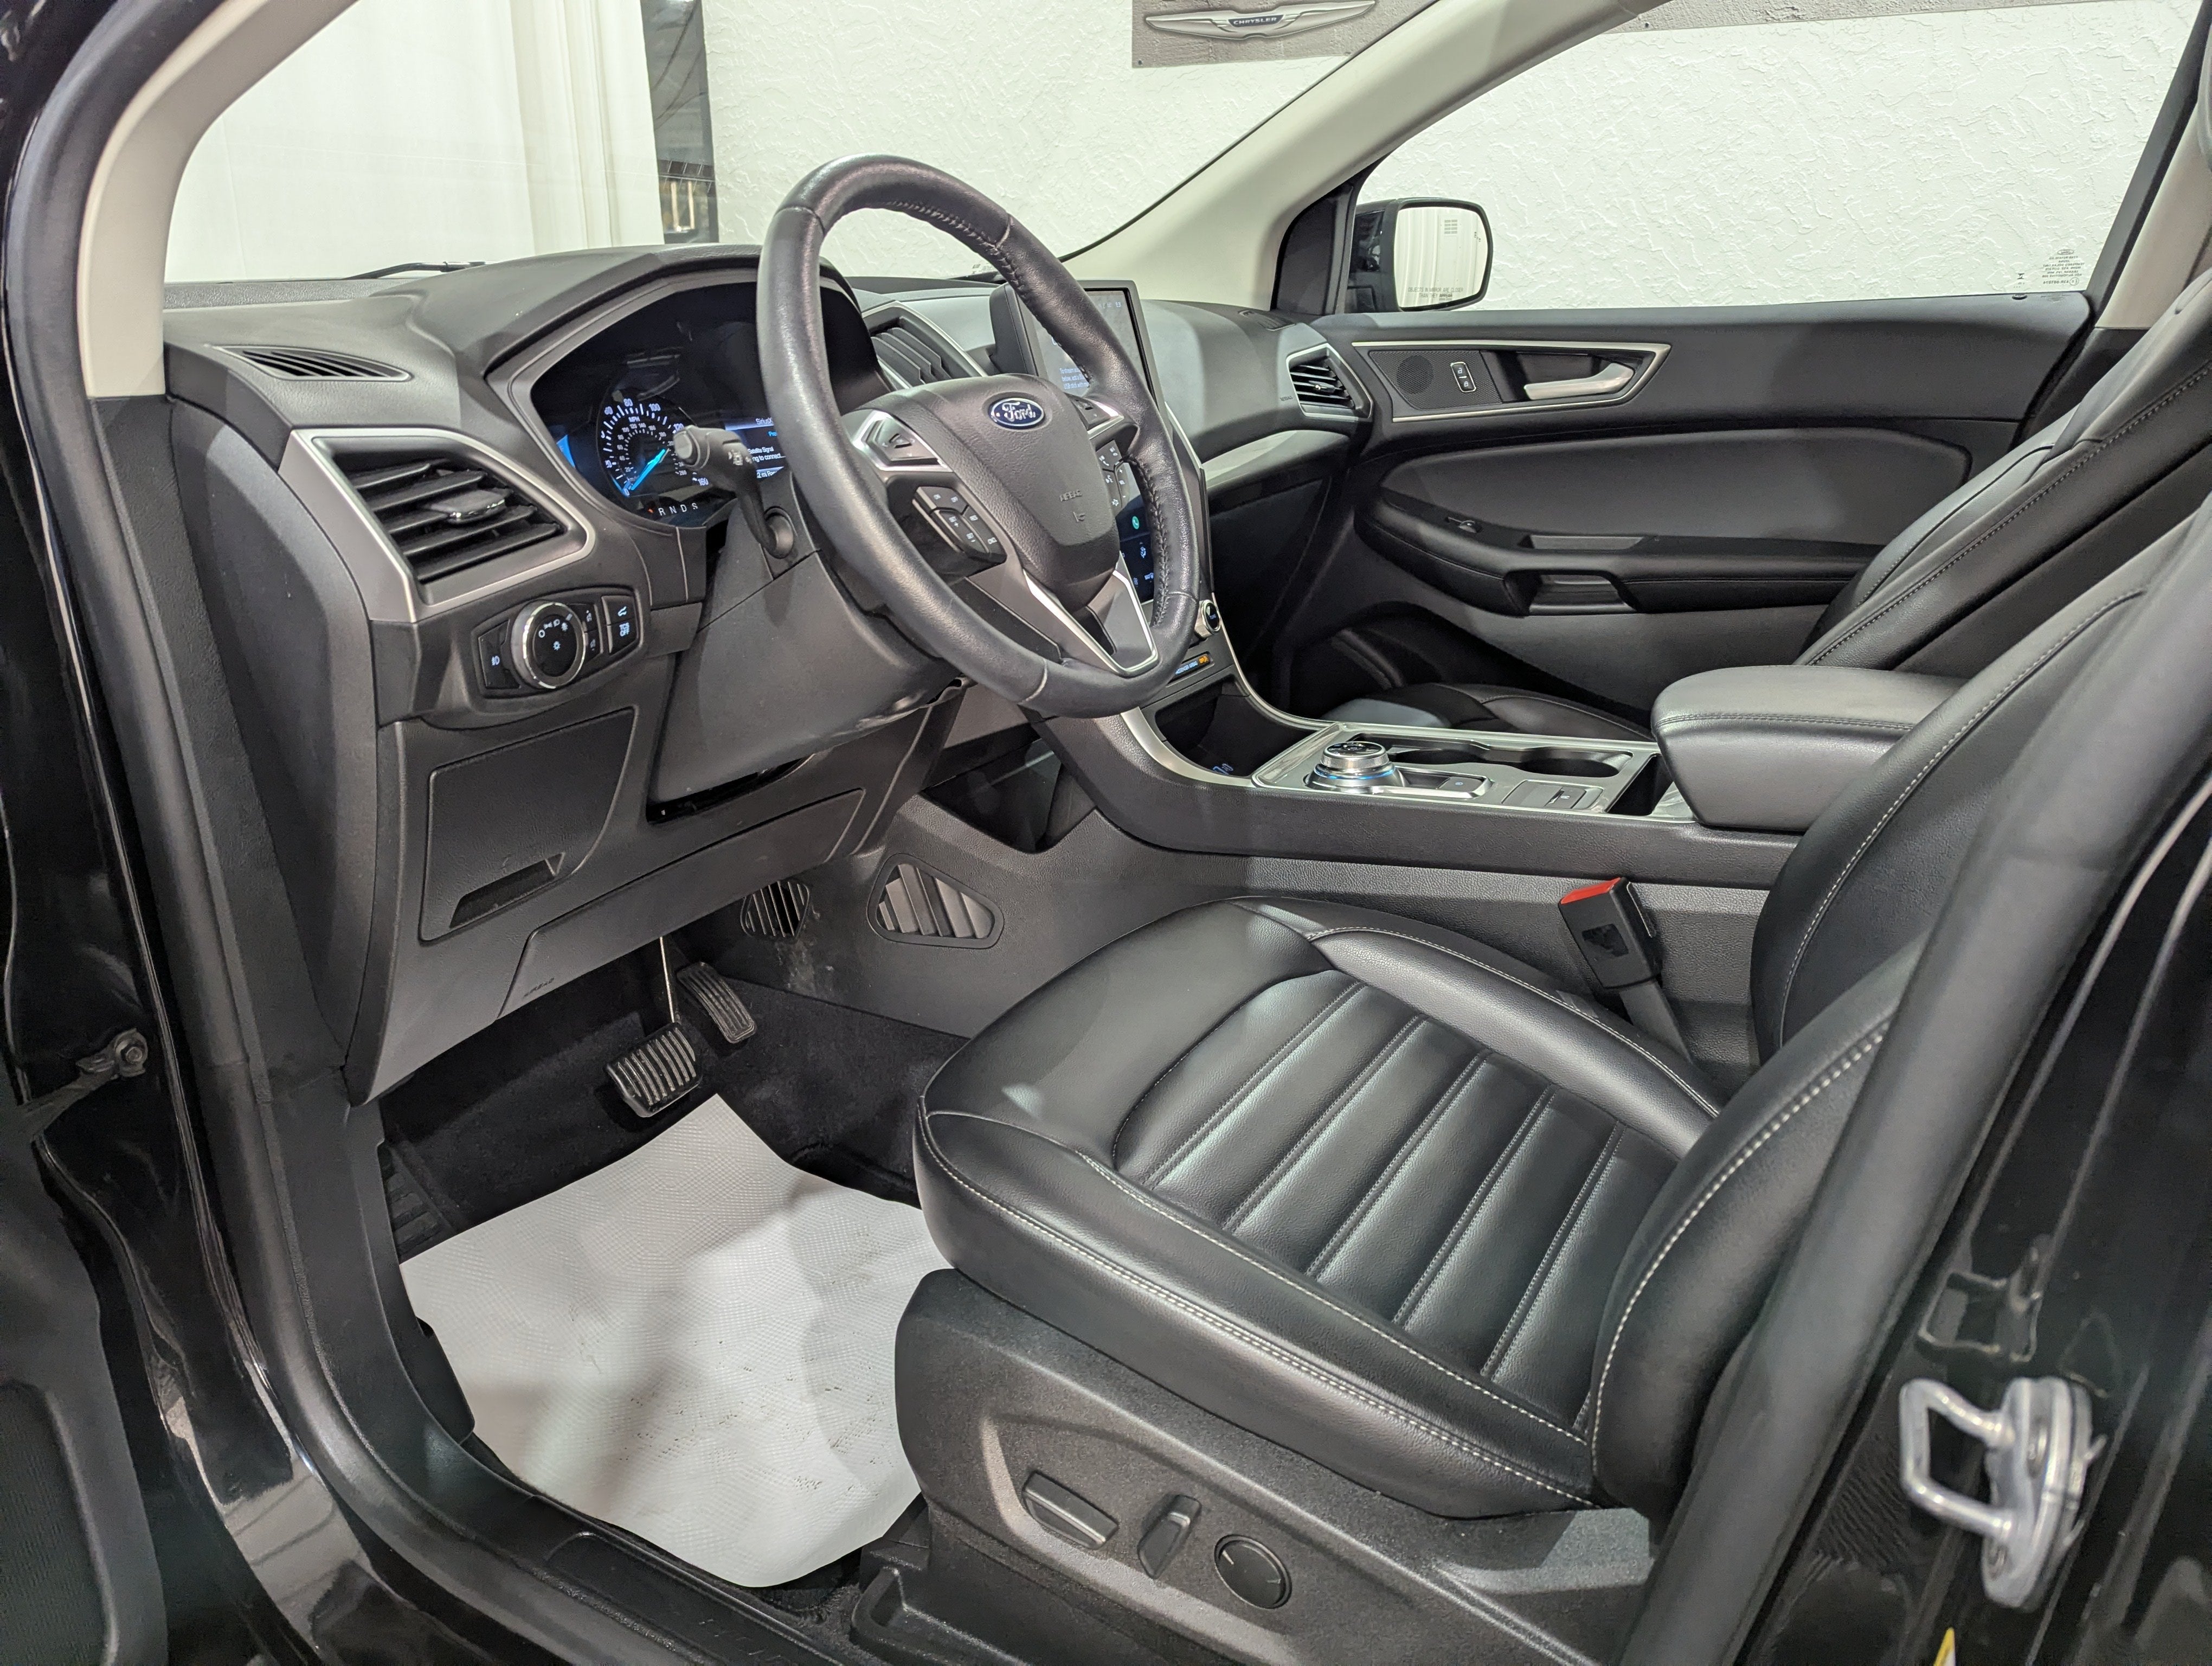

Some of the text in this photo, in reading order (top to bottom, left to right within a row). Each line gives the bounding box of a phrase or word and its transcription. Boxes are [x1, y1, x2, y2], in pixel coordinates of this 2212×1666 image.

[623, 398, 633, 407] 80
[604, 406, 613, 415] 60
[648, 403, 661, 412] 100
[1002, 401, 1036, 422] Ford
[673, 423, 684, 431] 120
[698, 478, 709, 486] 160
[658, 508, 666, 516] R
[669, 506, 677, 514] N
